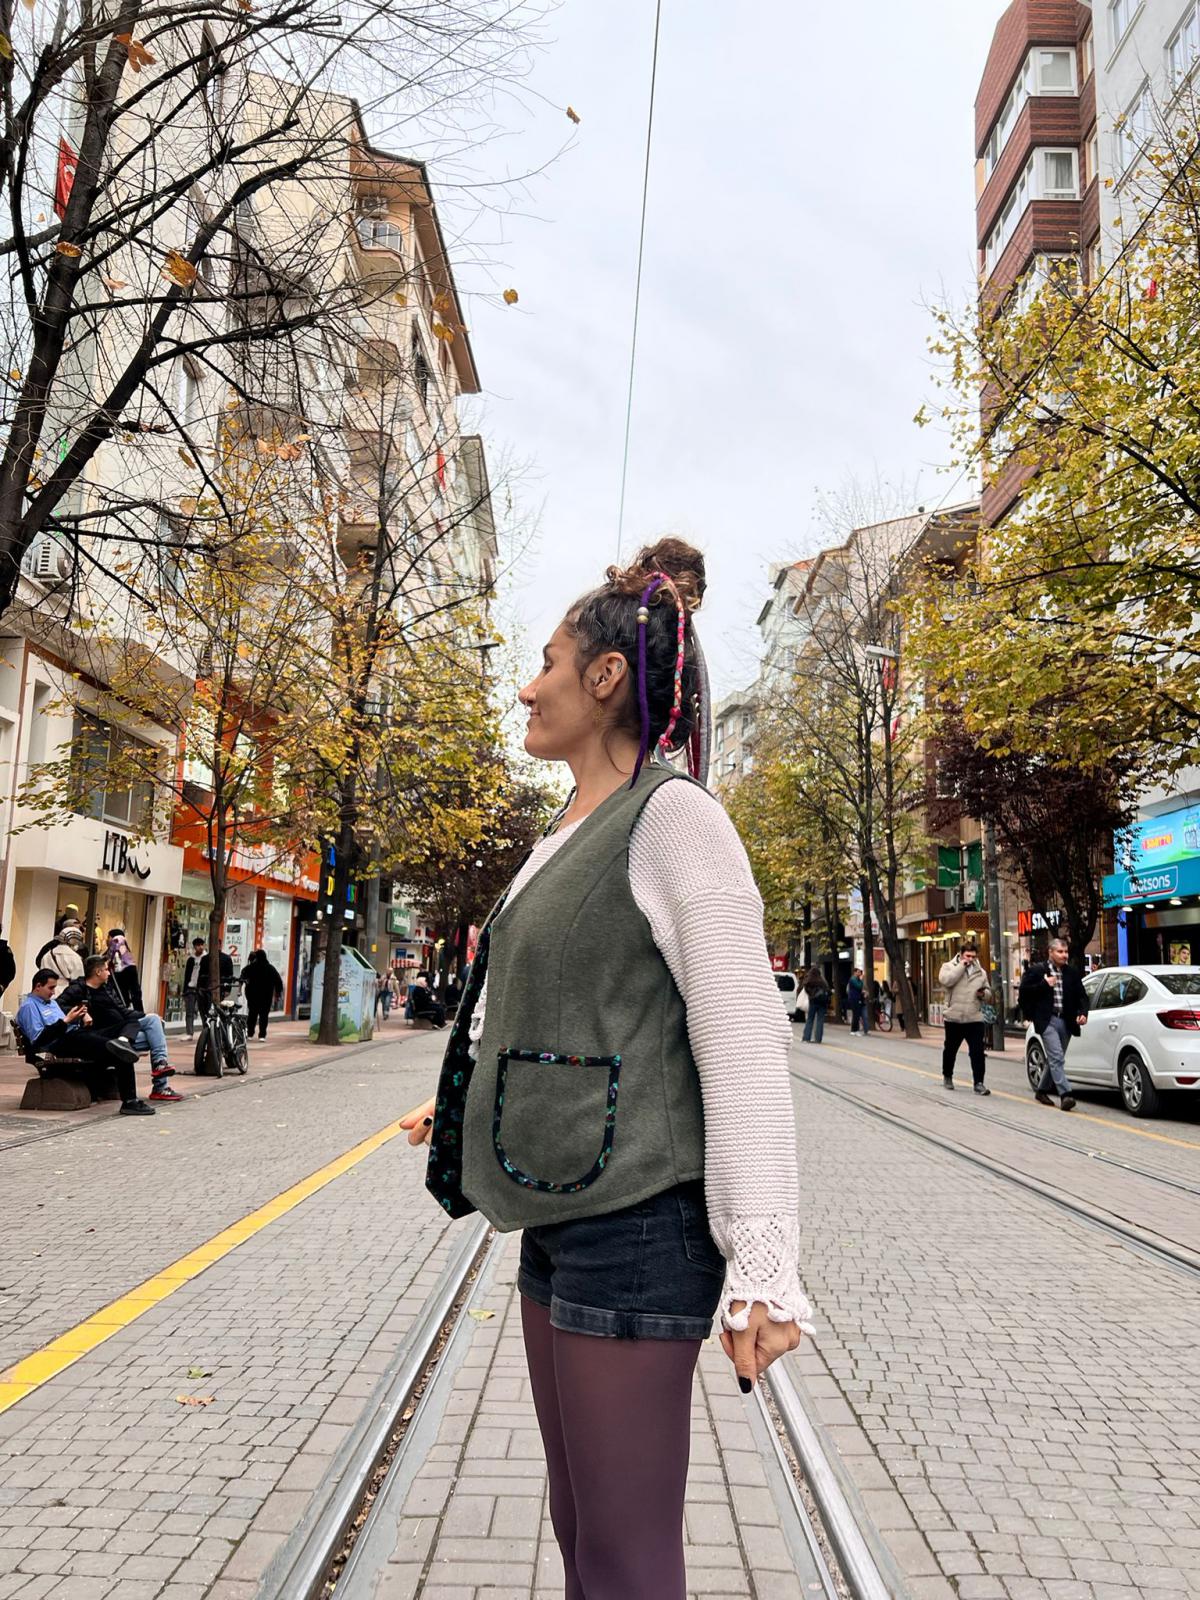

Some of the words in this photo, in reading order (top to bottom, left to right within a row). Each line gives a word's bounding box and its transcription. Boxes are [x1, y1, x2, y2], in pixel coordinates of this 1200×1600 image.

[103, 830, 128, 874] LTB
[1129, 874, 1171, 893] watsons
[1018, 911, 1032, 934] IN
